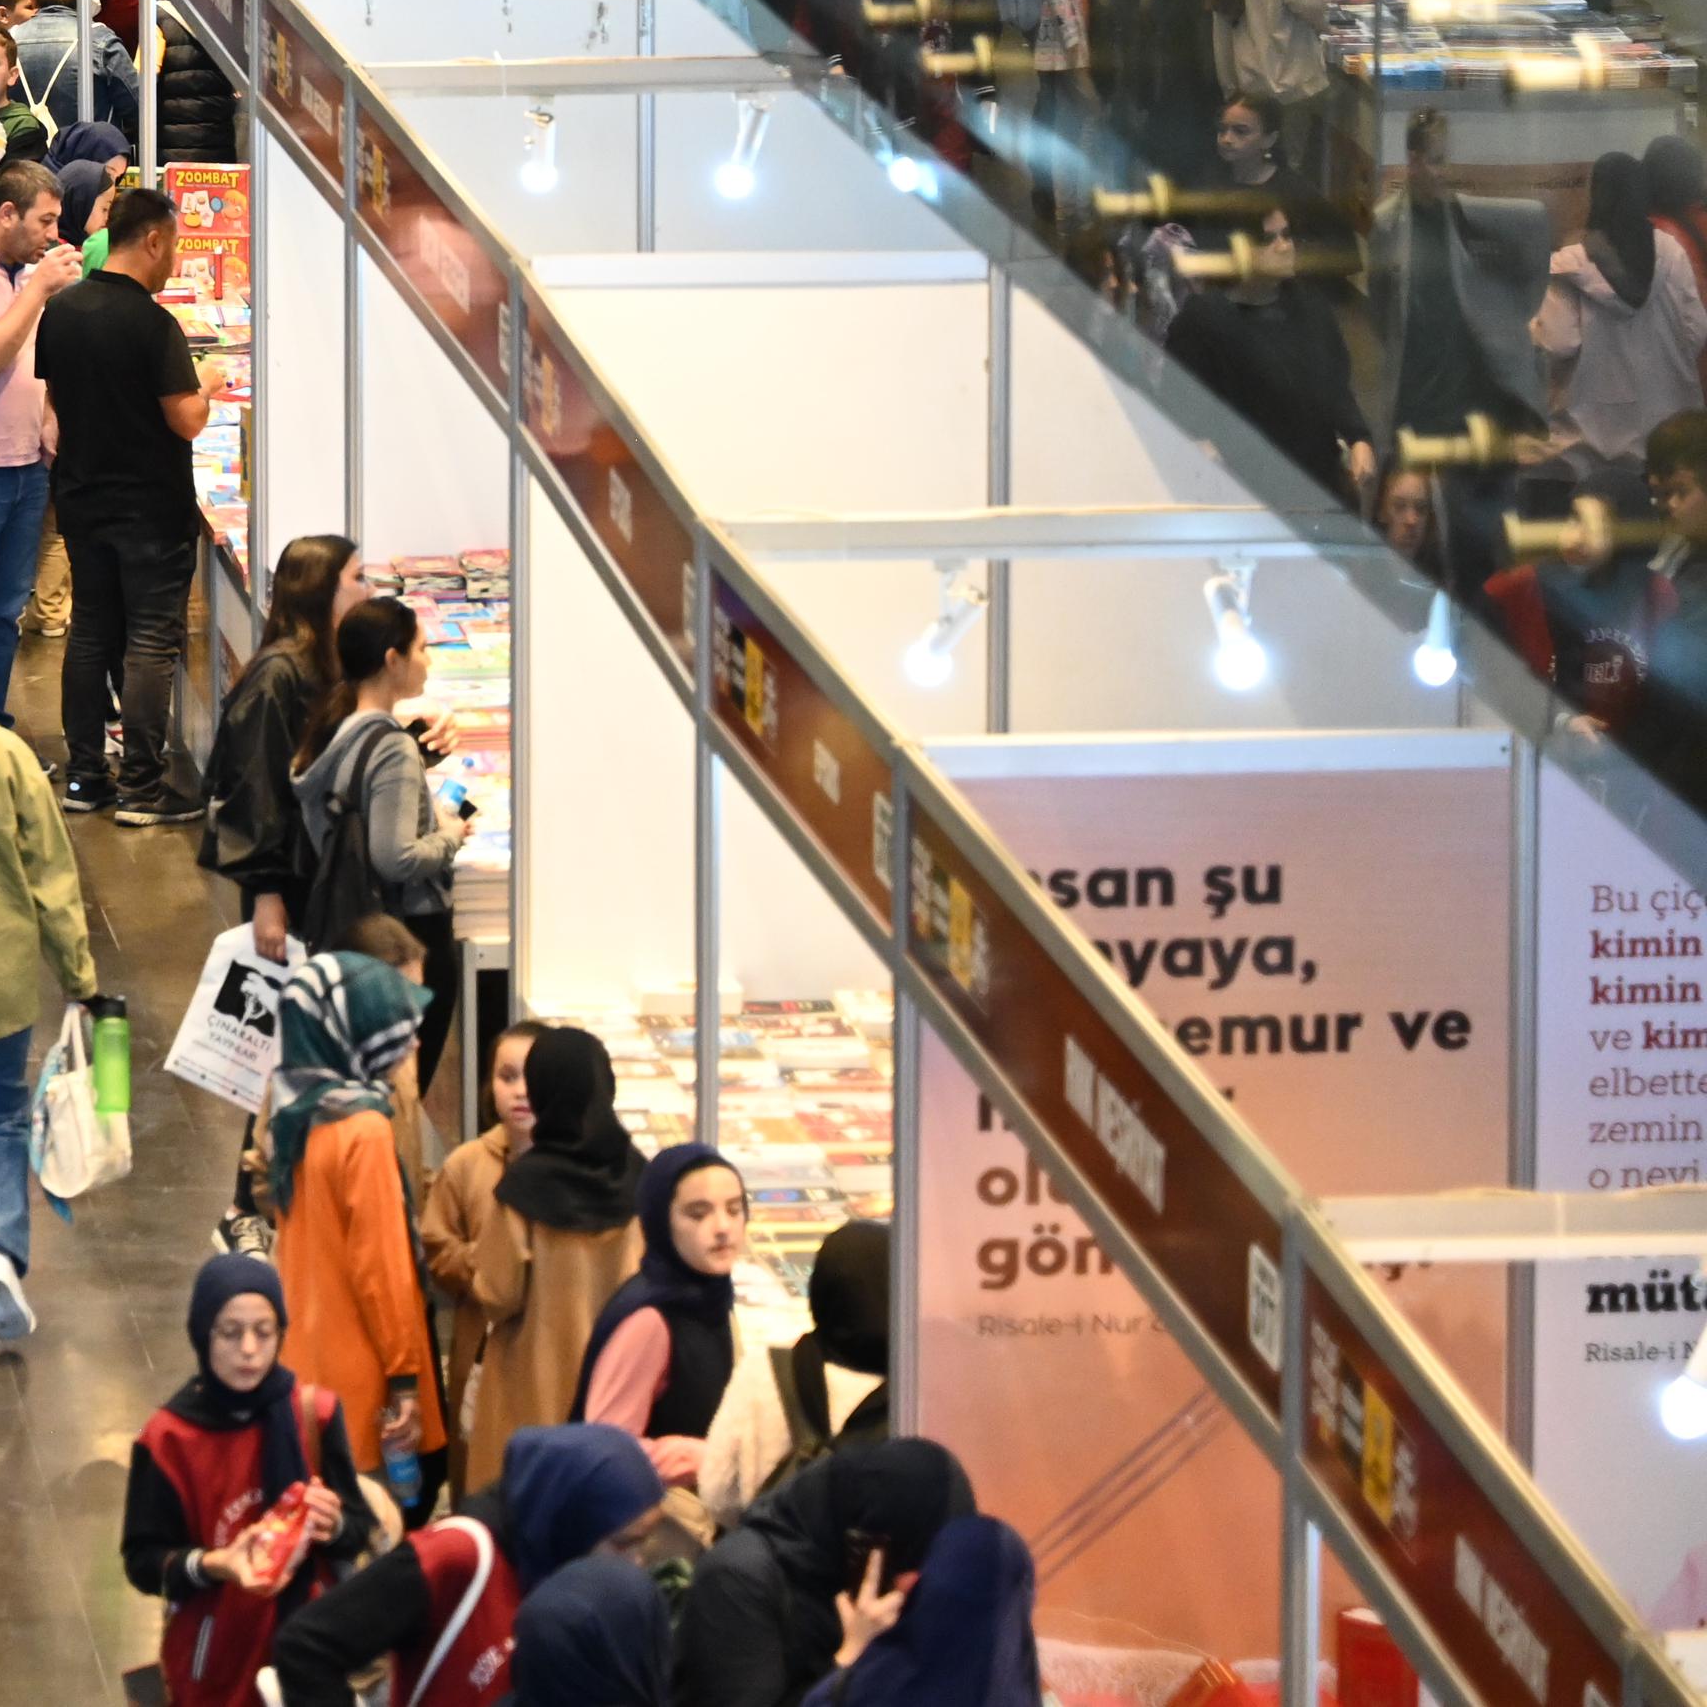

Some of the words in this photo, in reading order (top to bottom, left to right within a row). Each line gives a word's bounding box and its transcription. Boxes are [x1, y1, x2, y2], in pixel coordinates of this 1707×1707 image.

[175, 170, 240, 188] ZOOMBAT
[1203, 864, 1283, 919] şu
[1590, 885, 1639, 913] Bu
[1590, 930, 1702, 959] kimin
[1590, 976, 1701, 1005] kimin
[207, 1014, 271, 1051] ÇINARALTI
[1167, 1012, 1364, 1056] emur
[1387, 1009, 1473, 1053] ve
[1590, 1029, 1632, 1051] ve
[1589, 1116, 1703, 1143] zemin
[1589, 1170, 1610, 1190] o
[1620, 1161, 1699, 1190] nevi
[1091, 1313, 1143, 1334] Nur
[1584, 1341, 1676, 1364] Risale-i
